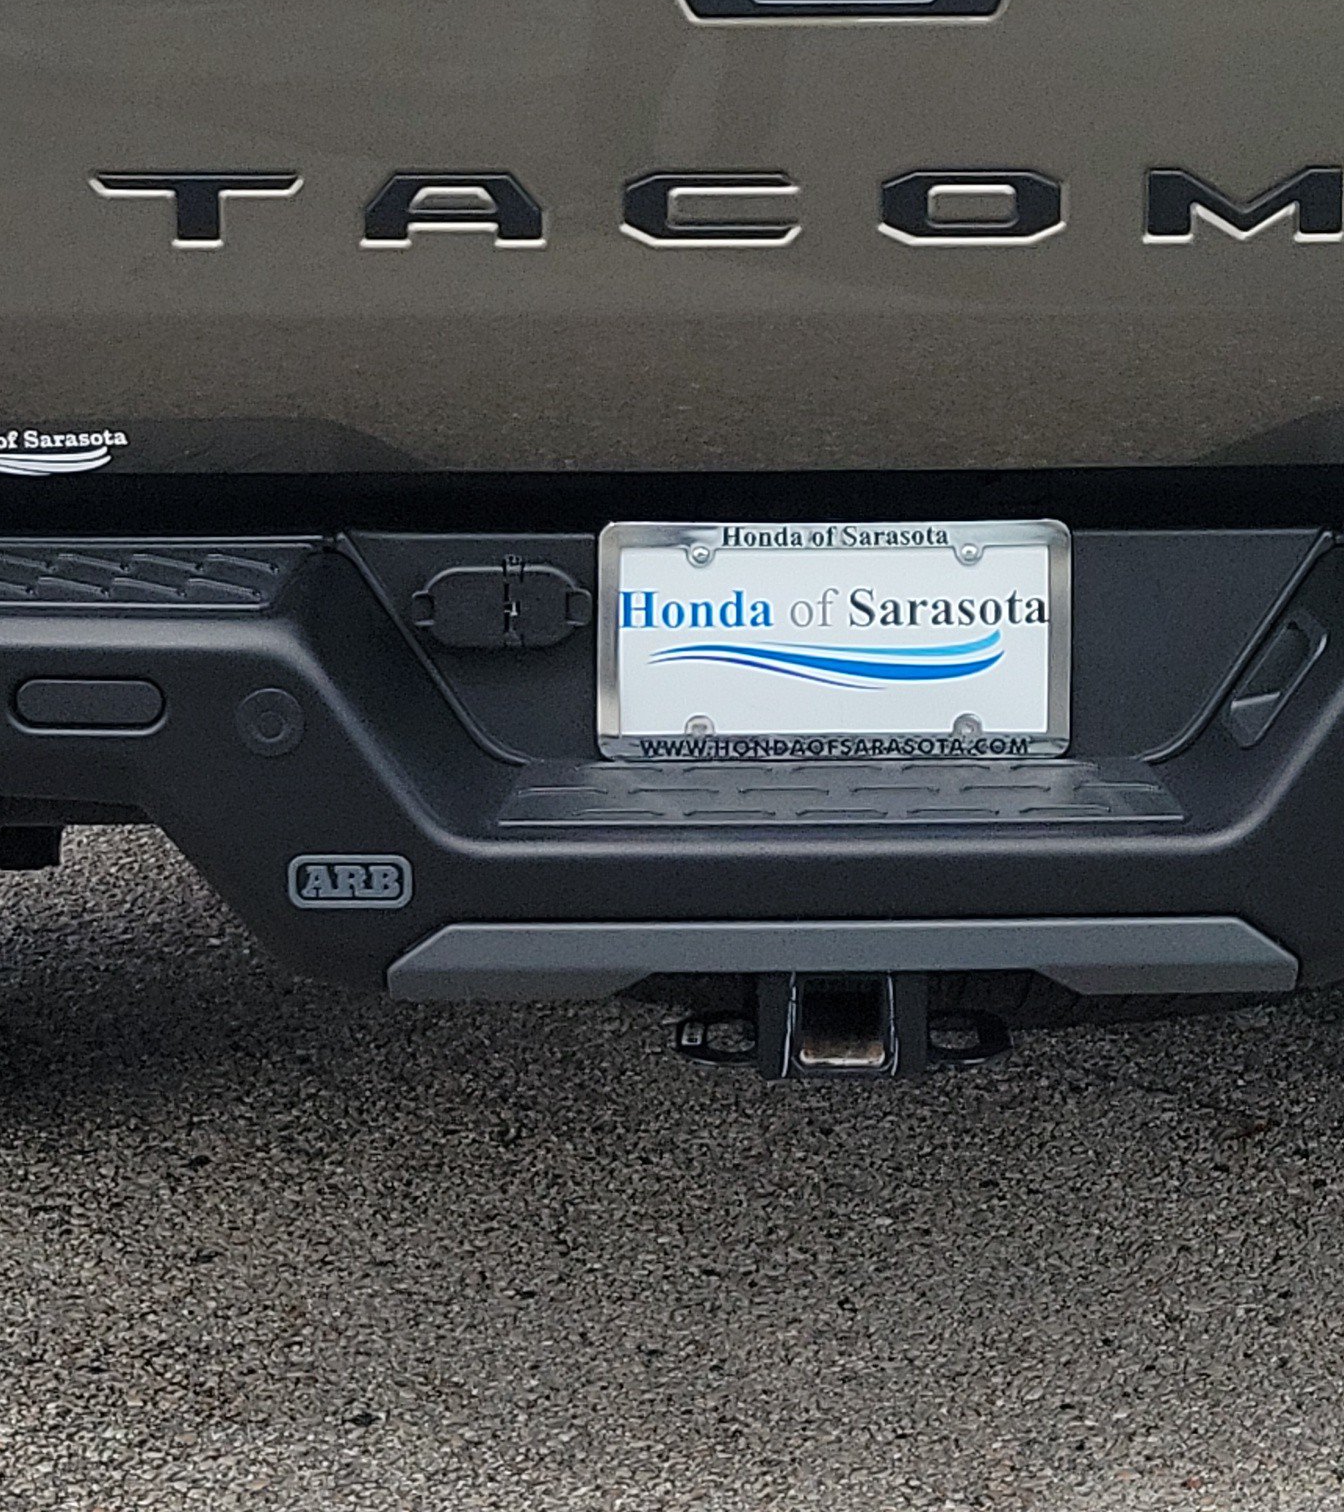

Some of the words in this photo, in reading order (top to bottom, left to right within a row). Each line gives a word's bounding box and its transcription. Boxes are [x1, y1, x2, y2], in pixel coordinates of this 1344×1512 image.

[23, 429, 128, 450] Sarasota
[722, 526, 803, 547] Honda
[812, 526, 836, 547] of
[842, 526, 949, 547] Sarasota
[619, 590, 773, 628] Honda
[790, 588, 838, 627] of
[849, 588, 1051, 627] Sarasota
[639, 737, 1030, 757] WWW.HONDAOFSARASOTA.COM
[301, 865, 400, 898] ARB
